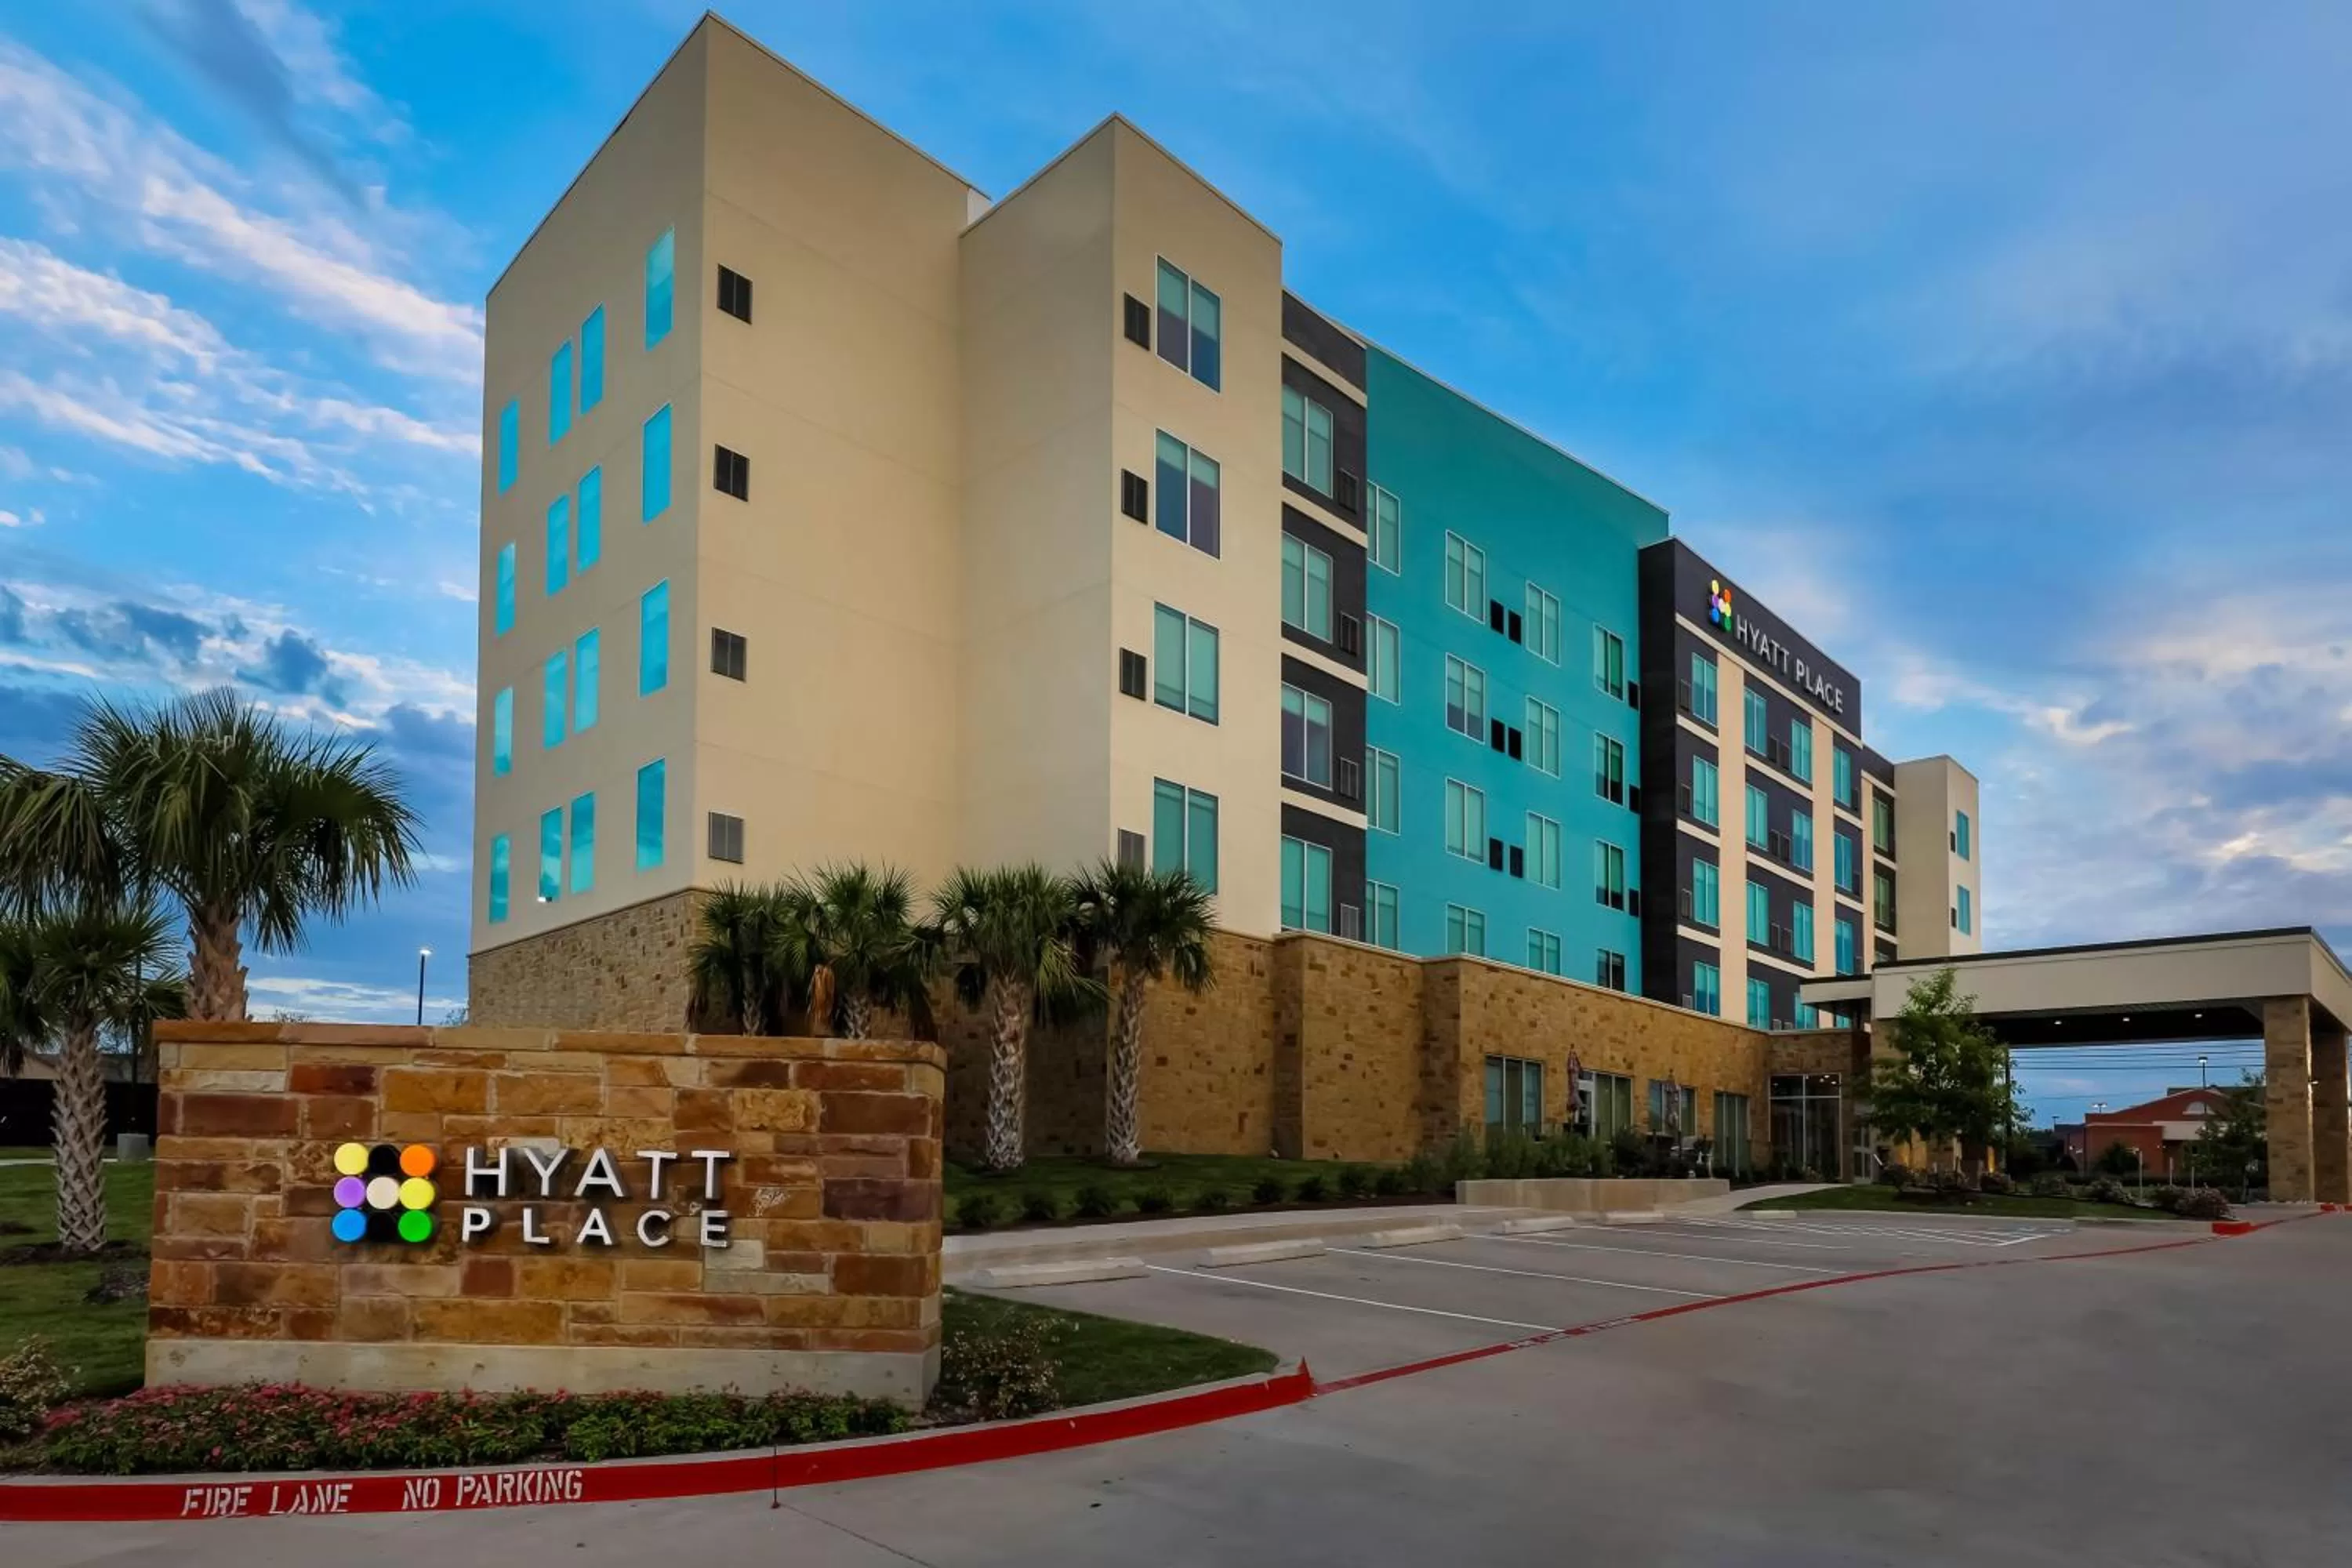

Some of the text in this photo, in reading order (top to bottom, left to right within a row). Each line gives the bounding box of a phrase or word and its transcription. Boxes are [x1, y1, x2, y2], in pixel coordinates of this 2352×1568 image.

[1736, 614, 1843, 713] HYATT PLACE
[464, 1146, 731, 1200] HYATT
[461, 1207, 730, 1248] PLACE
[180, 1470, 583, 1518] FIRE LANE NO PARKING
